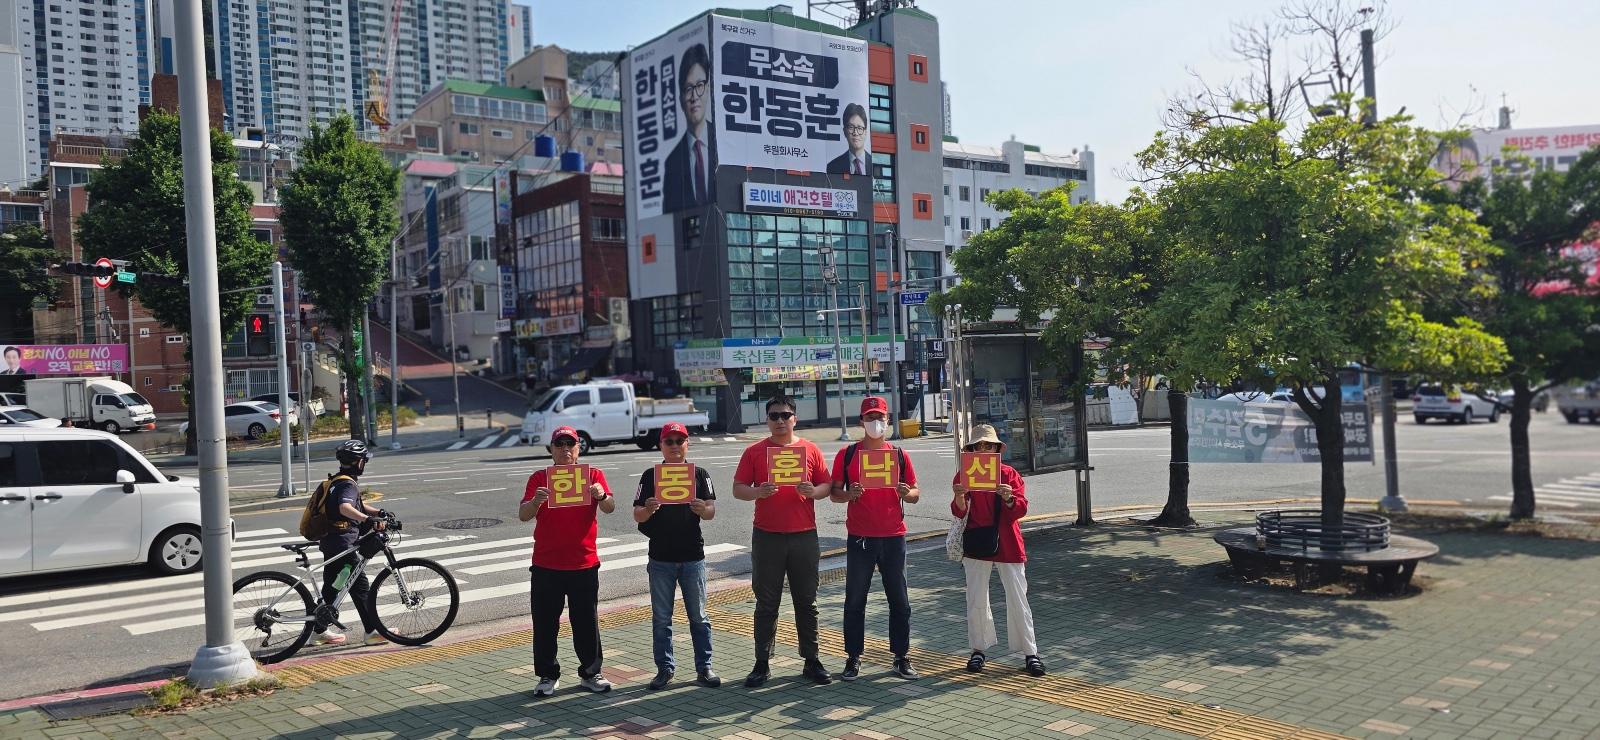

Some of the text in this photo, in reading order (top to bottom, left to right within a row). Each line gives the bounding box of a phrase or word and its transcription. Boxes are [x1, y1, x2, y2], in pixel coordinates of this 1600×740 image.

[748, 46, 815, 84] 무소속
[662, 65, 677, 133] 무소속
[721, 82, 841, 141] 한동훈
[635, 65, 661, 201] 한동훈
[763, 144, 808, 158] 후원회사무소
[750, 189, 833, 208] 로이네 애견호텔
[48, 360, 111, 372] 오직 교육만!
[733, 349, 777, 364] 축산물
[658, 466, 693, 500] 동
[771, 449, 804, 484] 훈
[861, 453, 895, 486] 낙
[966, 455, 997, 489] 선
[551, 467, 587, 503] 한
